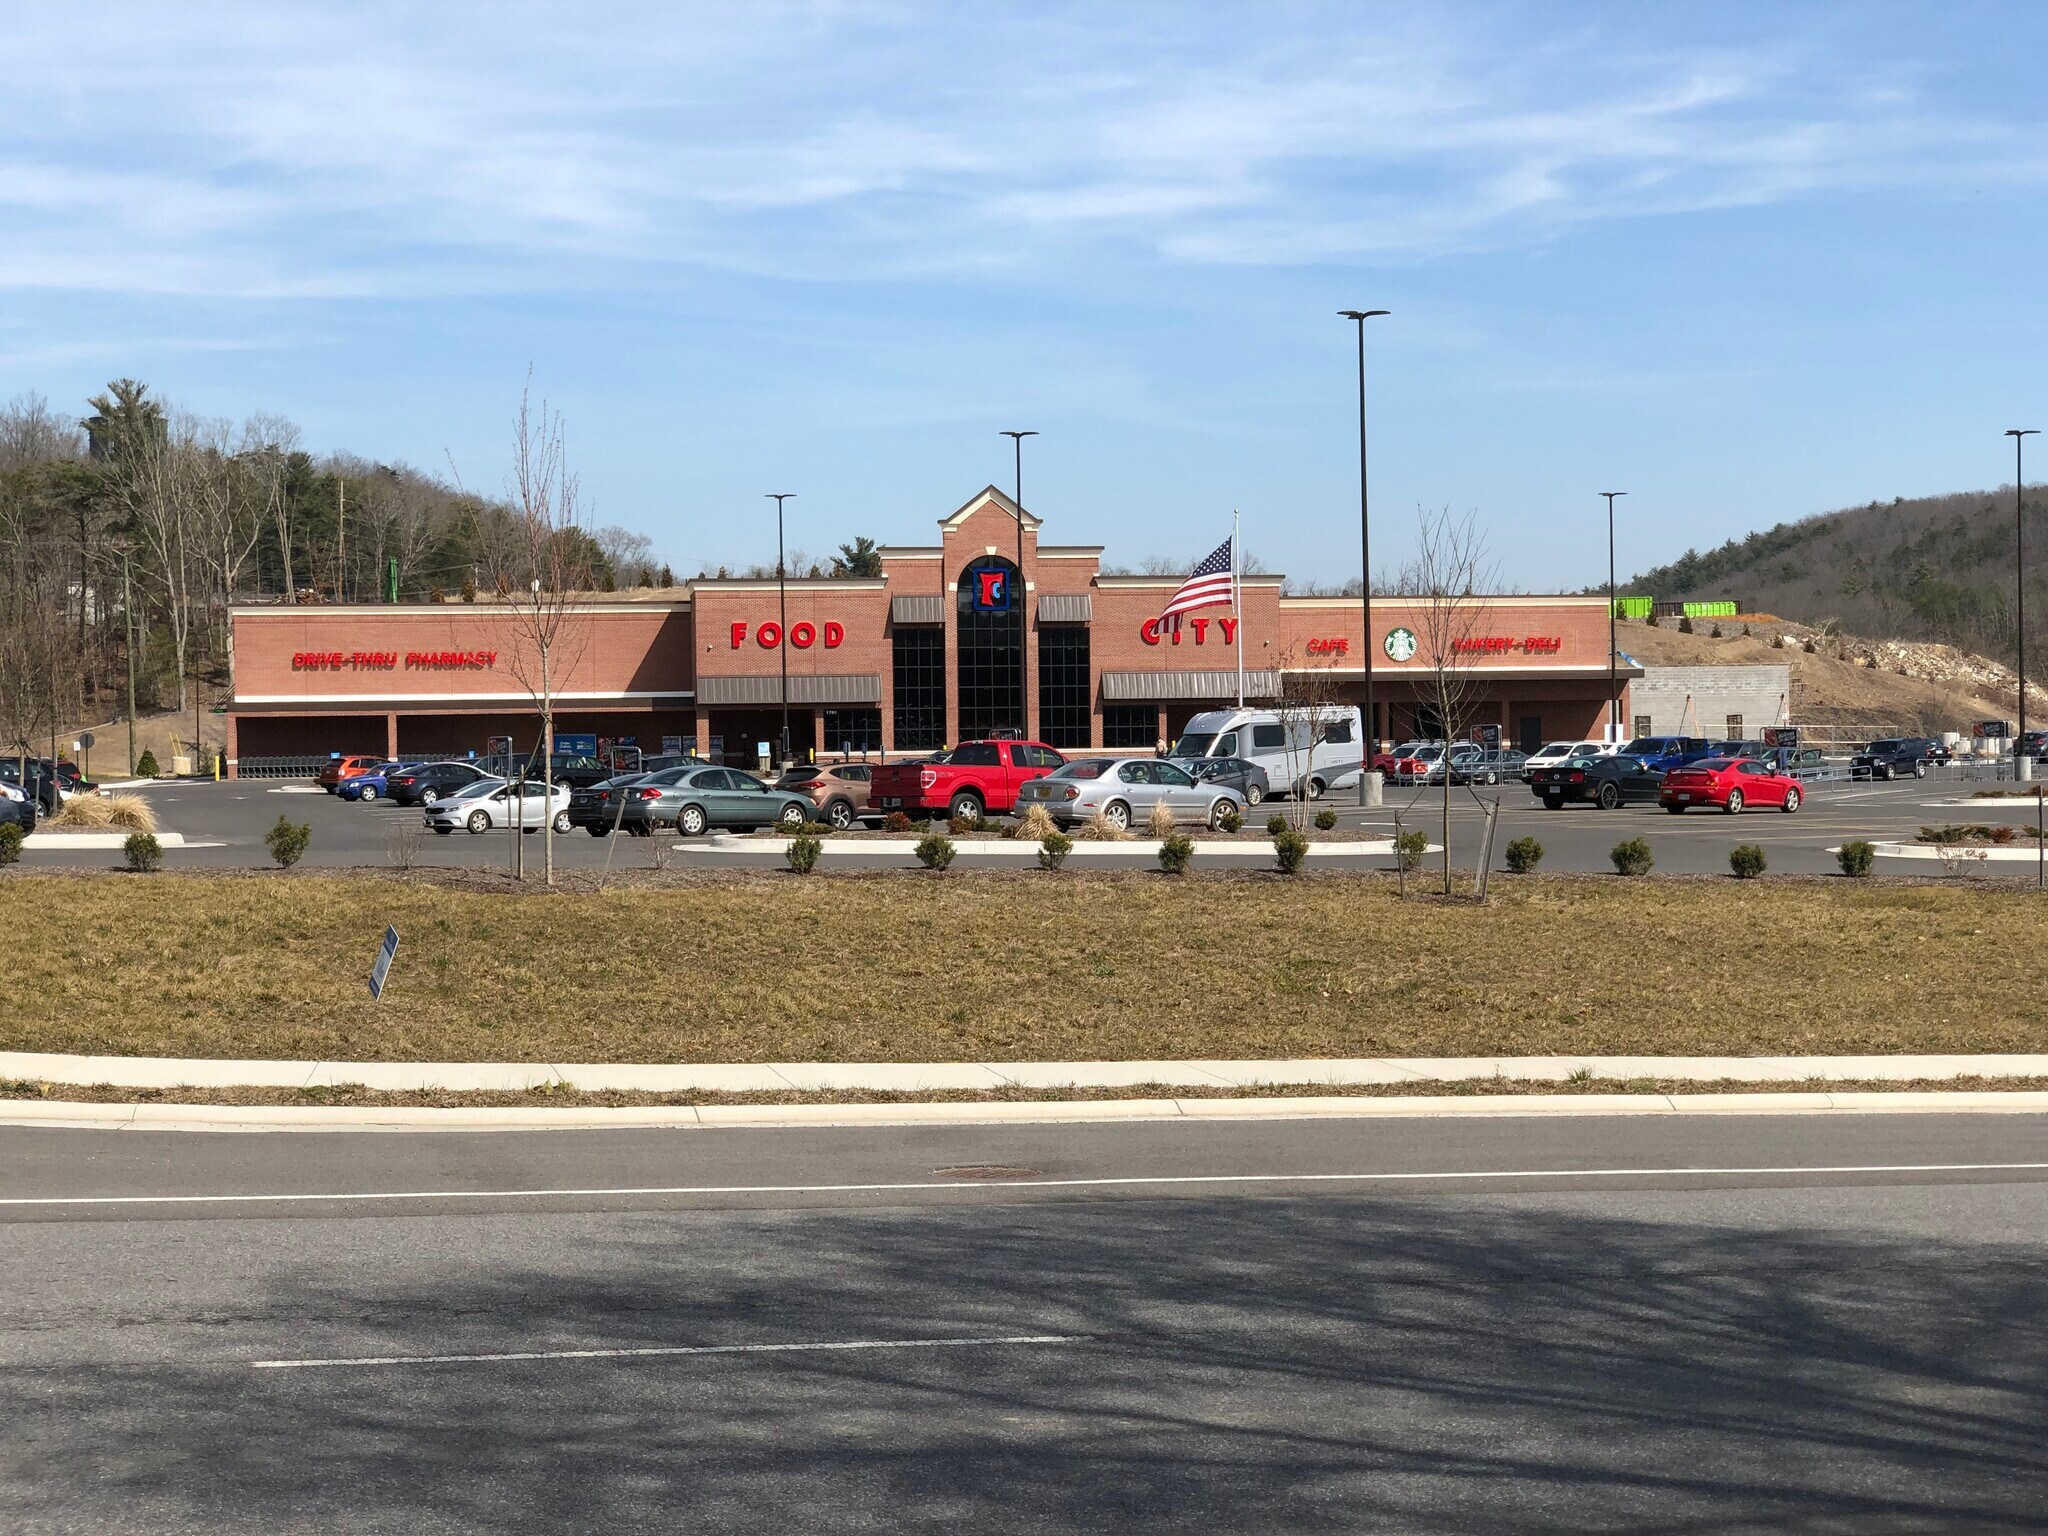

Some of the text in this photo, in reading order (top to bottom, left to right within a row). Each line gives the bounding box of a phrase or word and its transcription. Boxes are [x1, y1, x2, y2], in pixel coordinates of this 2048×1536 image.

[731, 622, 845, 649] FOOD
[1308, 637, 1349, 652] CAFE
[294, 651, 499, 666] DRIVE-THRU PHARMACY
